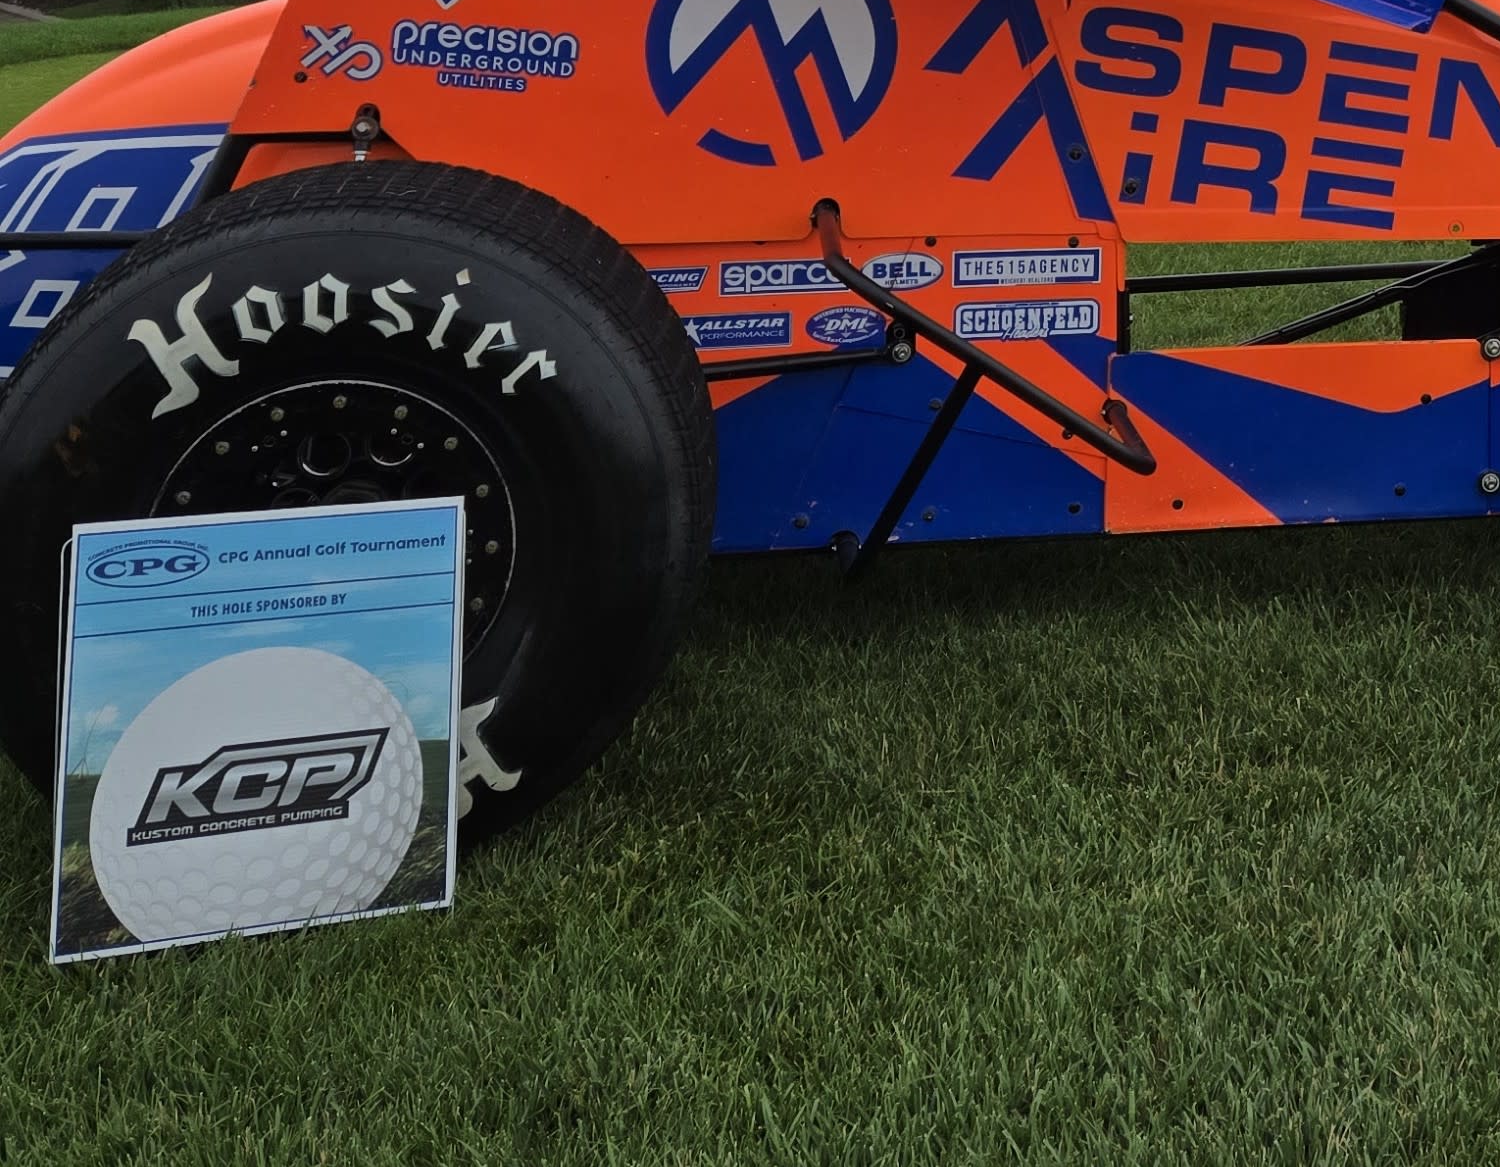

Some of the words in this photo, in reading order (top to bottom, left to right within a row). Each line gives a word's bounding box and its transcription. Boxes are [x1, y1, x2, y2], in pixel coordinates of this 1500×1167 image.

[392, 21, 578, 60] precision
[393, 48, 574, 77] UNDERGROUND
[438, 72, 525, 91] UTILITIES
[884, 278, 919, 286] HELMETS
[700, 318, 785, 331] ALLSTAR
[824, 316, 869, 332] DMI
[962, 306, 1092, 332] SCHOENFELD
[126, 268, 557, 420] Hoosier
[700, 330, 785, 341] PERFORMANCE
[218, 550, 249, 564] CPG
[253, 544, 310, 561] Annual
[315, 541, 346, 556] Golf
[351, 534, 446, 553] Tournament
[93, 554, 202, 580] CPG
[190, 604, 218, 618] THIS
[222, 601, 253, 616] HOLE
[256, 596, 327, 613] SPONSORED
[331, 593, 347, 605] BY
[145, 734, 381, 824] KCP
[132, 825, 194, 842] KUSTOM
[199, 814, 276, 833] CONCRETE
[281, 806, 343, 823] PUMPING
